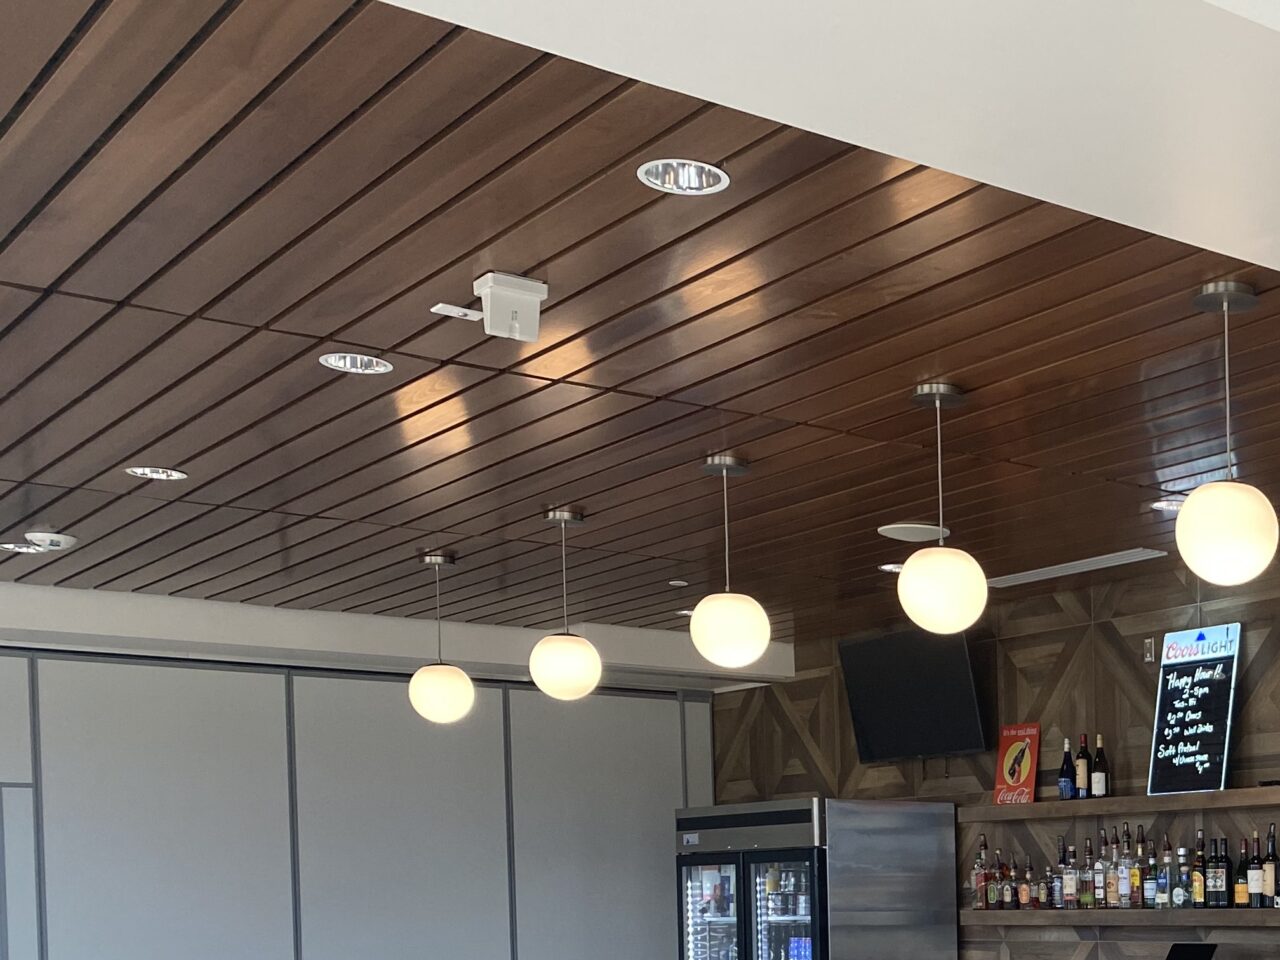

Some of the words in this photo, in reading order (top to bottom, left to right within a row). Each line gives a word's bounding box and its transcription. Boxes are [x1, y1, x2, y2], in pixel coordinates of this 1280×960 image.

[1166, 642, 1200, 660] Coors
[1201, 640, 1234, 655] LIGHT
[1166, 671, 1192, 690] Happy
